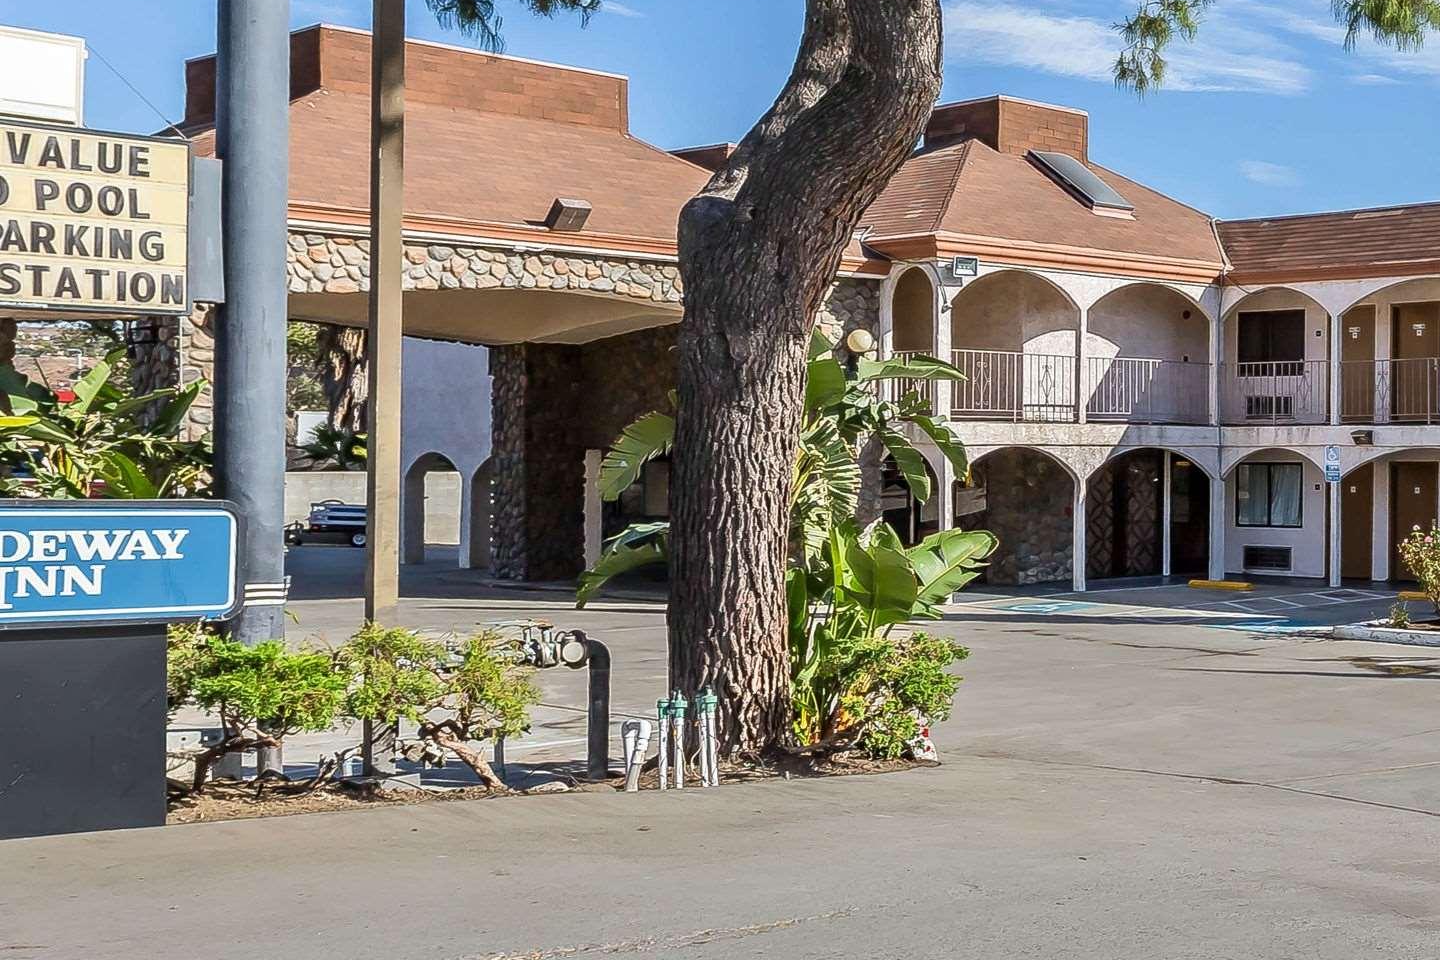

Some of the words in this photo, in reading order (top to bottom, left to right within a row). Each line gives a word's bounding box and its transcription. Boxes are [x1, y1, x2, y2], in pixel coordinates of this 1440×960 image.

[6, 131, 150, 178] VALUE
[34, 178, 150, 220] POOL
[0, 219, 165, 262] ARKING
[0, 262, 184, 305] STATION
